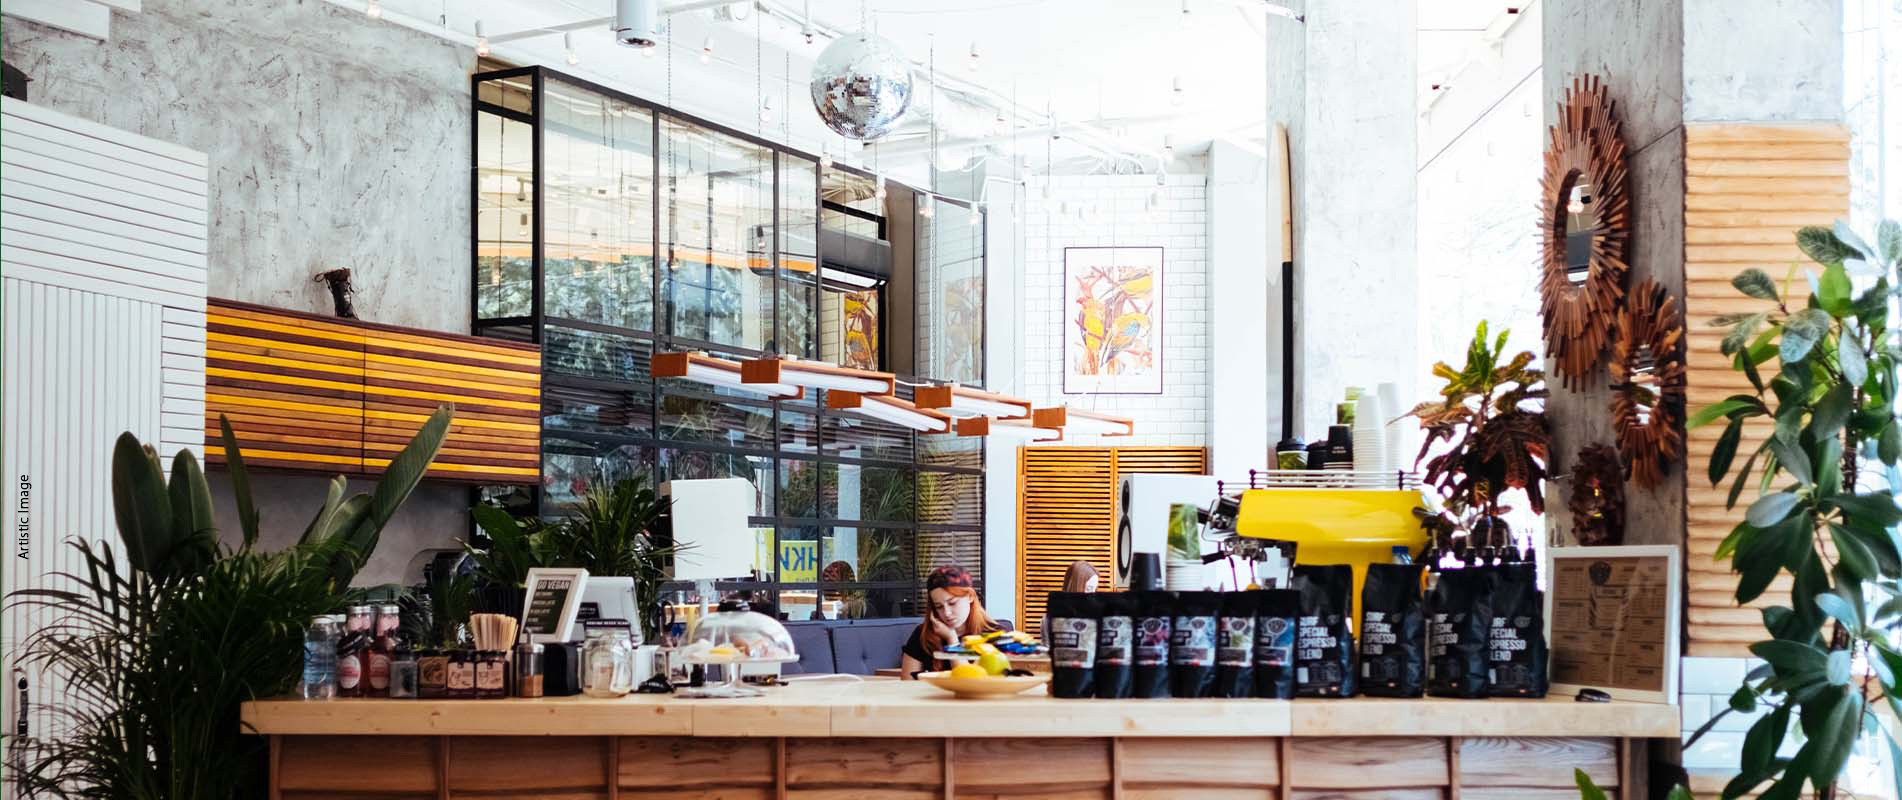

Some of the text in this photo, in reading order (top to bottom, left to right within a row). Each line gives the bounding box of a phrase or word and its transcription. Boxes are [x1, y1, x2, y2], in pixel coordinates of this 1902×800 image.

[547, 581, 571, 590] VEGAN
[1490, 628, 1518, 639] PECIAL
[1489, 639, 1527, 651] SPRESSO
[1490, 650, 1512, 662] LEND
